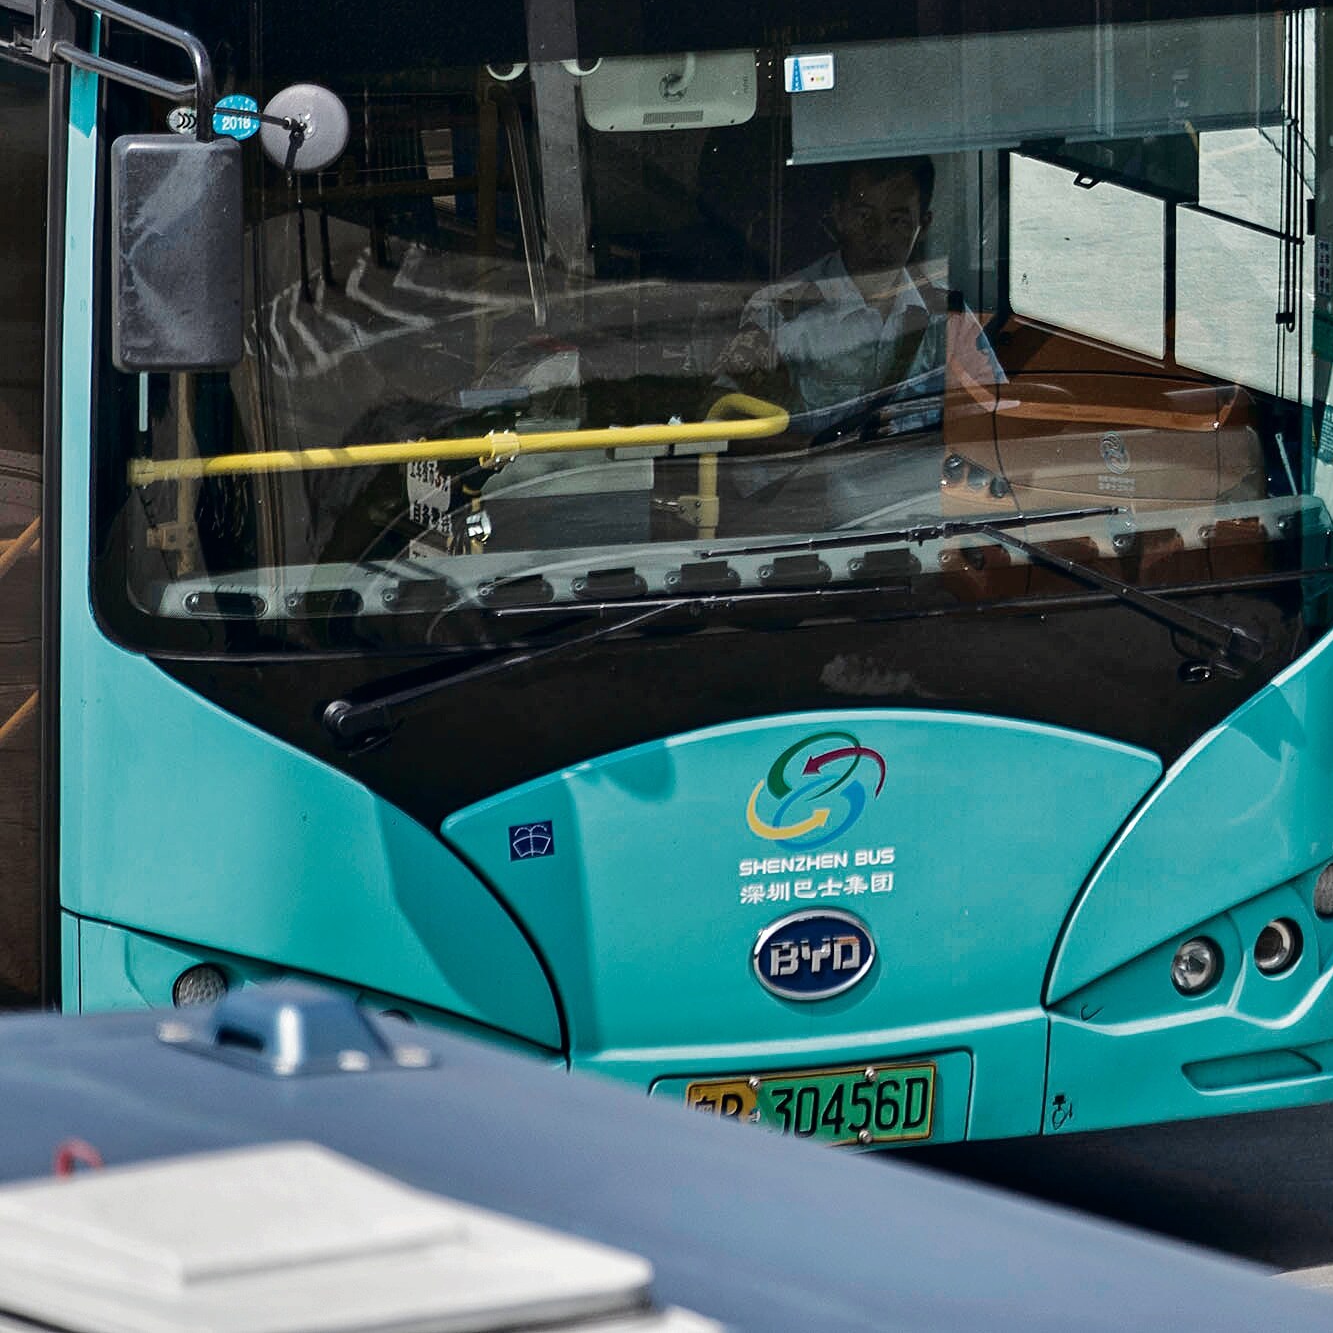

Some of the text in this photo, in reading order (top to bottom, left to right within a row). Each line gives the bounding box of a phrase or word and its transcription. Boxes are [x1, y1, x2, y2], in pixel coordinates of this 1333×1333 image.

[738, 843, 896, 877] SHENZHEN BUS
[740, 871, 895, 905] 深圳巴士集团
[770, 934, 861, 977] BYD
[771, 1077, 929, 1139] 30456D
